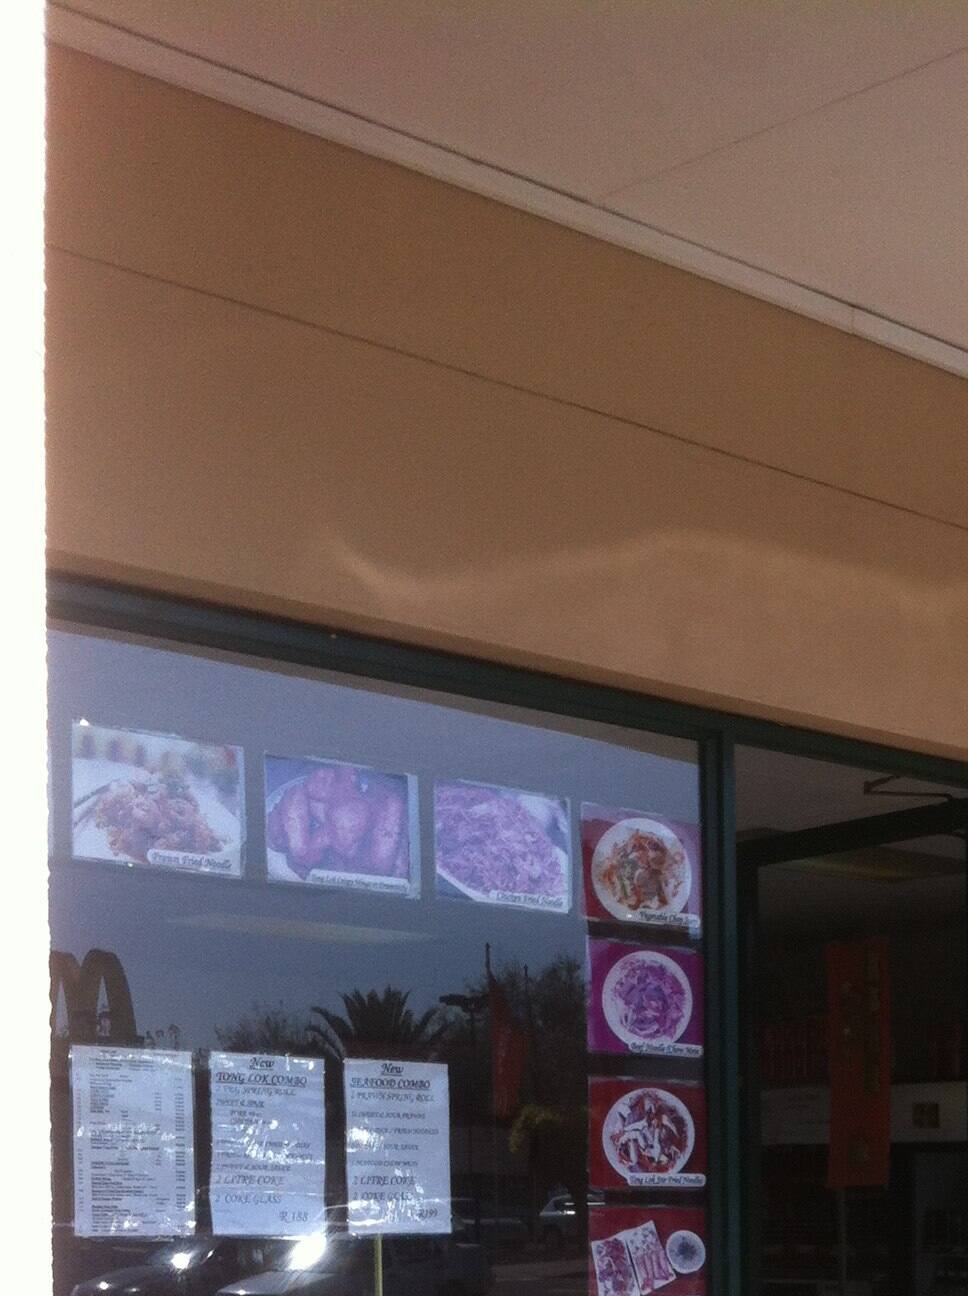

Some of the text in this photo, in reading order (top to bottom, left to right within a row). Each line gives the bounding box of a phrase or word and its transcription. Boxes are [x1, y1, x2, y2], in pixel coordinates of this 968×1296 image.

[249, 1056, 275, 1070] New
[381, 1063, 405, 1075] New
[216, 1072, 308, 1088] TONG LOK COMBO
[350, 1077, 432, 1091] SEAFOOD COMBO
[223, 1174, 255, 1186] LITRE
[256, 1174, 285, 1187] COKE
[360, 1175, 390, 1187] LITRE
